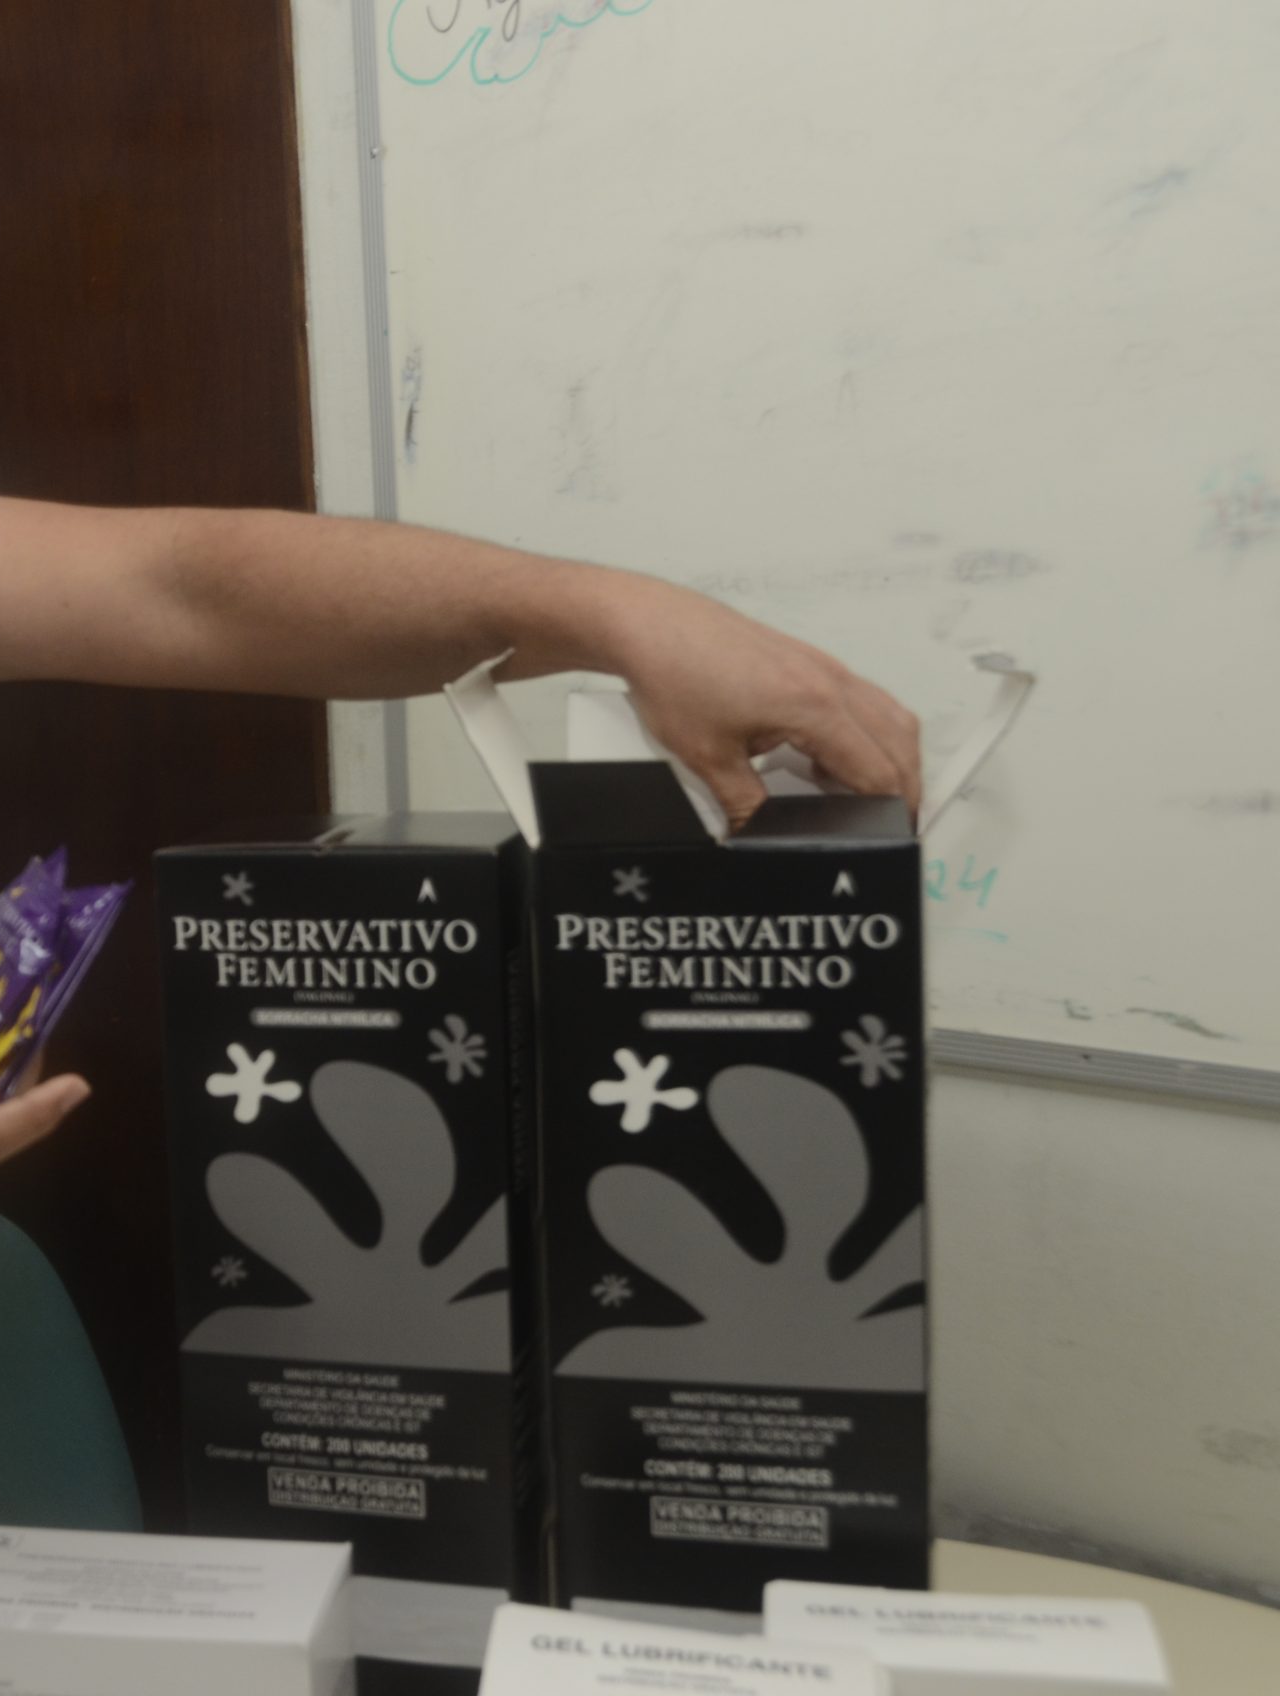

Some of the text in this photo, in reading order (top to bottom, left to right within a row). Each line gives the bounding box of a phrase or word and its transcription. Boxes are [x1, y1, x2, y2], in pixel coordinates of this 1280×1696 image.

[272, 1472, 420, 1499] VENDA PROIBIDA
[530, 1632, 592, 1656] GEL
[601, 1639, 834, 1682] LUBRIFICANTE
